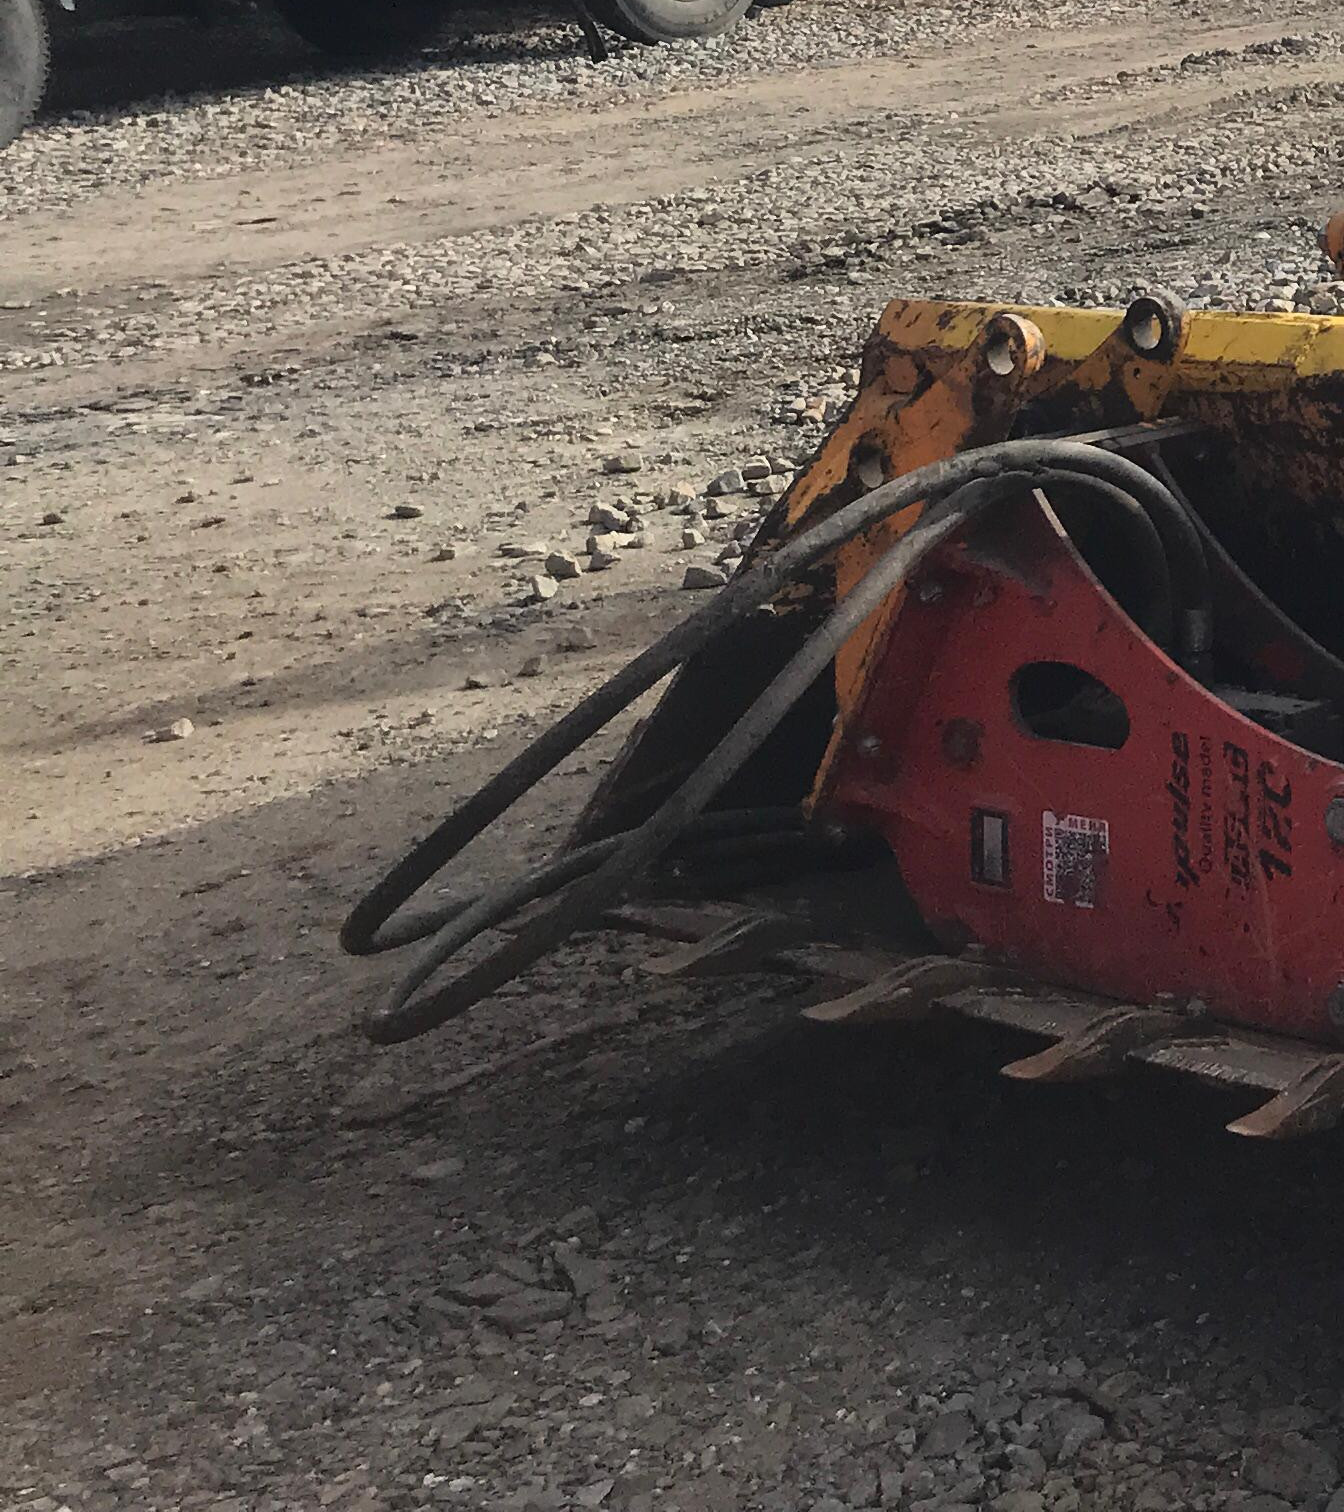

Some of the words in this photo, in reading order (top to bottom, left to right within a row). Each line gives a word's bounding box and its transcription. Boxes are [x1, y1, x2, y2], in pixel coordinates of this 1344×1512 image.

[1199, 735, 1213, 798] made!
[1160, 732, 1200, 908] pulse
[1199, 803, 1213, 875] Quality
[1045, 826, 1054, 897] СМОТРИ
